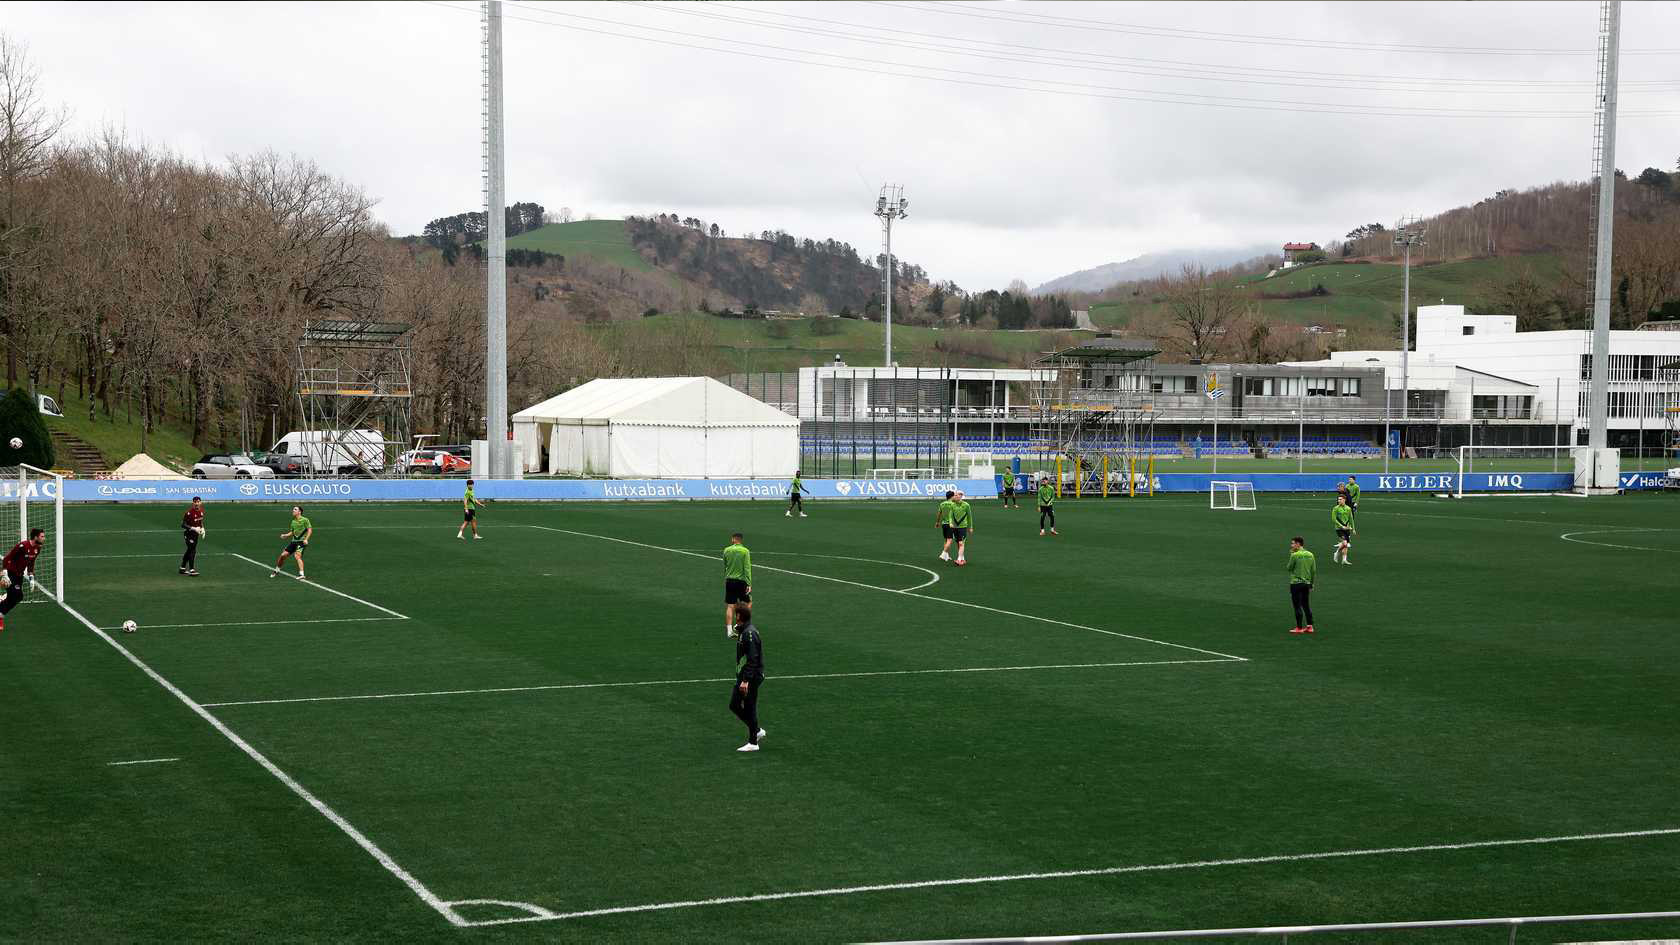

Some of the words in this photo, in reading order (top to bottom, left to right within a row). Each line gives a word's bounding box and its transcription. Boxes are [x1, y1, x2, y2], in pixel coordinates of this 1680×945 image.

[854, 481, 922, 495] YASUDA
[925, 483, 958, 495] group
[1378, 475, 1453, 489] KELER
[1487, 474, 1524, 489] IMQ
[114, 486, 157, 494] LEXUS
[165, 486, 181, 494] SAN
[264, 483, 351, 495] EUSKOAUTO
[603, 482, 686, 497] kutxabank
[710, 482, 787, 496] kutxabank
